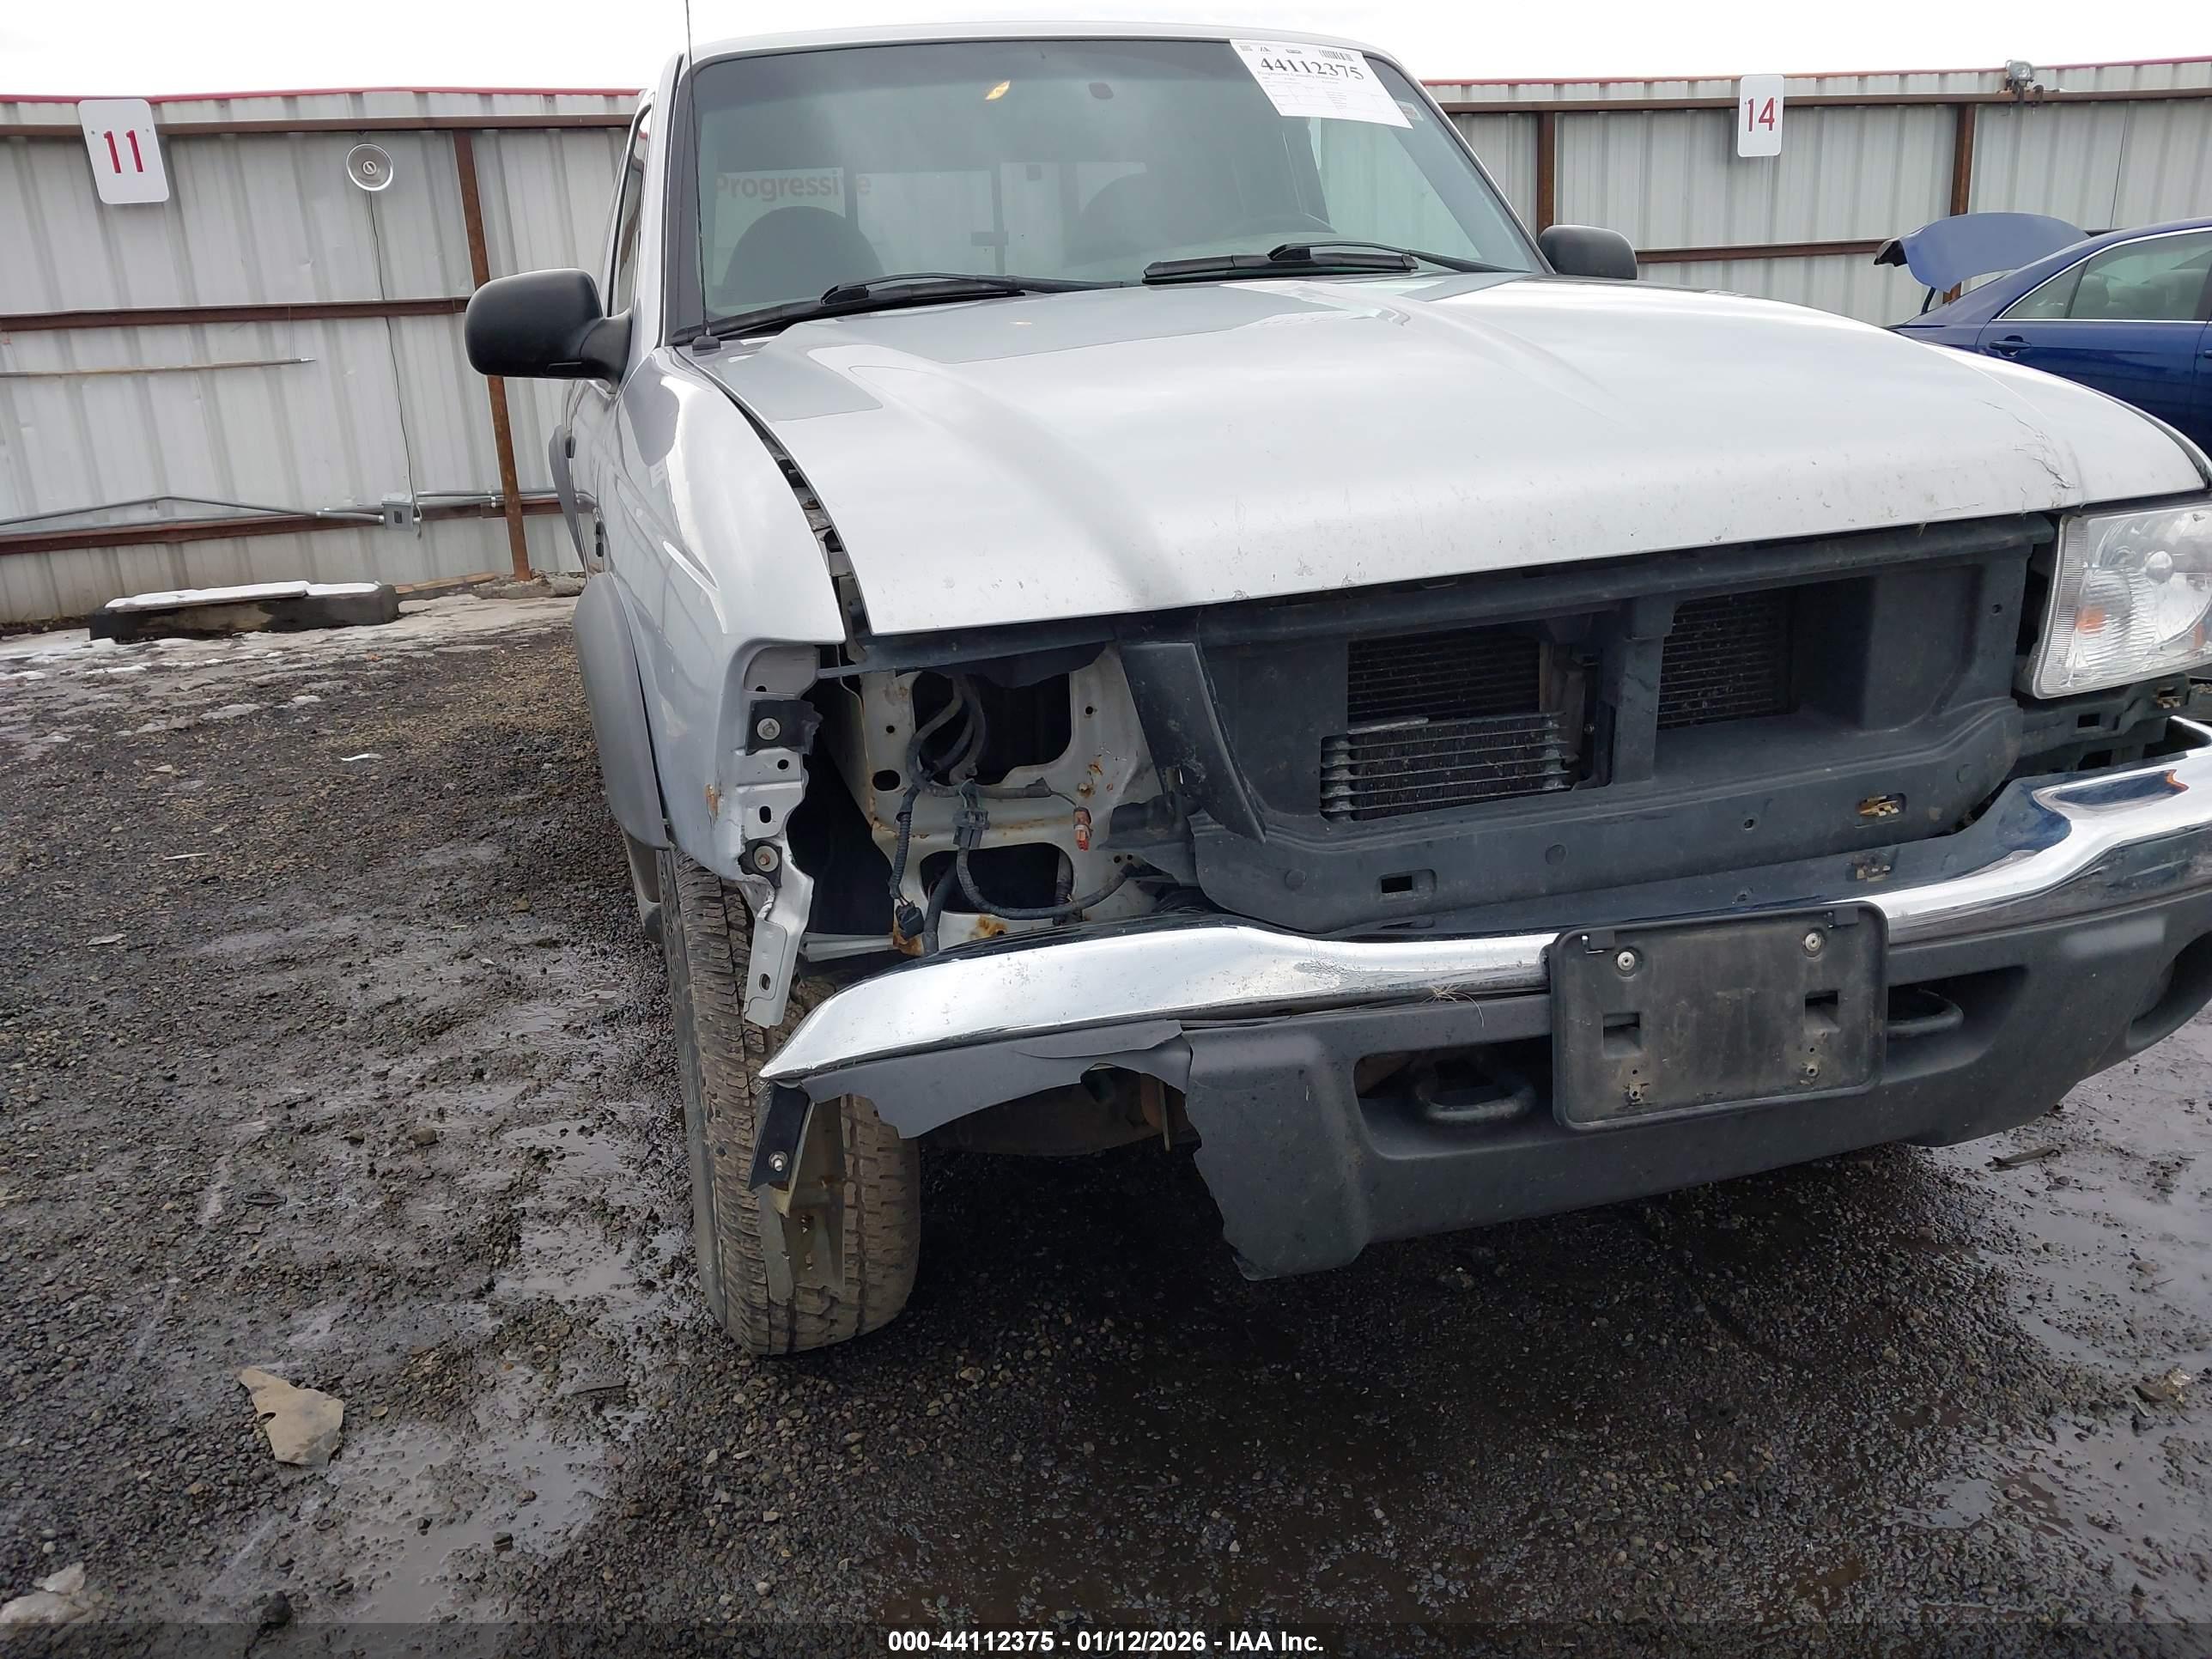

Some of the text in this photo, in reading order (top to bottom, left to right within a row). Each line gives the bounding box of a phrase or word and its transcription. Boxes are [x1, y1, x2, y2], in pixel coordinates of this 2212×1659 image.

[1261, 58, 1364, 80] 44112375
[1747, 97, 1775, 132] 14
[103, 130, 143, 173] 11
[714, 169, 872, 203] Progressie
